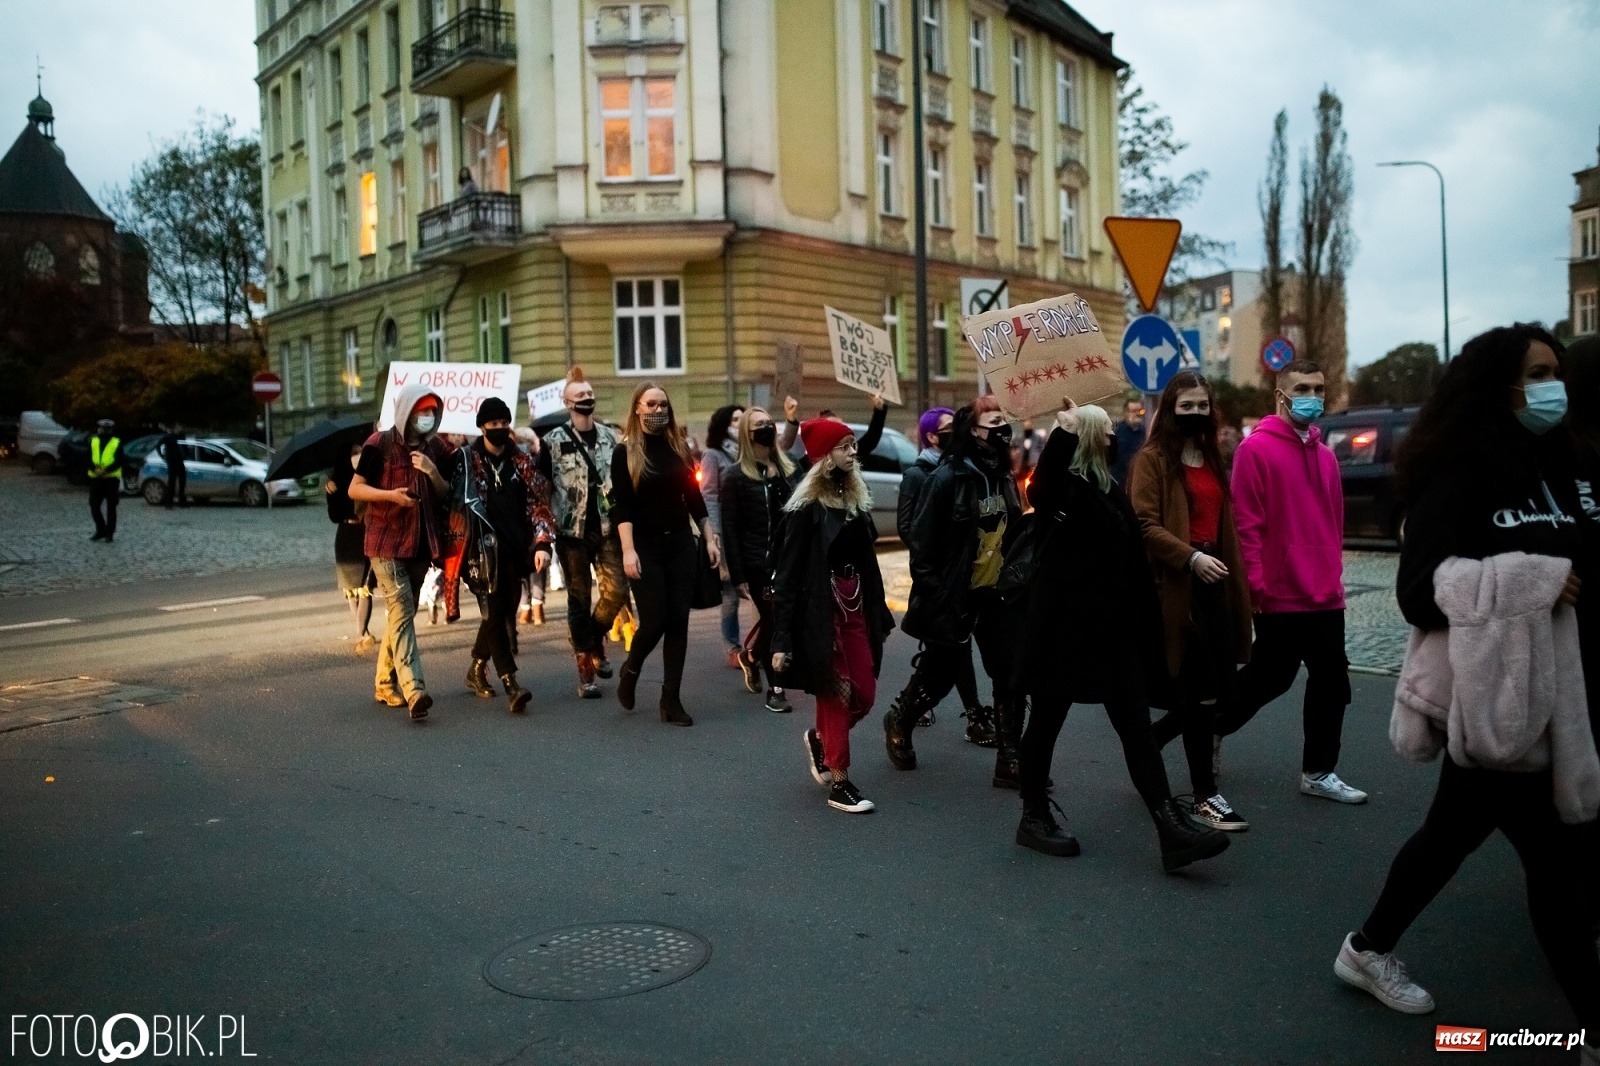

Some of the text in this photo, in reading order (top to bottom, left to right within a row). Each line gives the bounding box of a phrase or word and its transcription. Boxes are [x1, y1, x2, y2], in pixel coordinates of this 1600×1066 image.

[831, 314, 874, 345] TWÓJ
[839, 336, 867, 358] BÓL
[840, 351, 885, 378] LEPSZY
[394, 371, 505, 389] W OBRONIE
